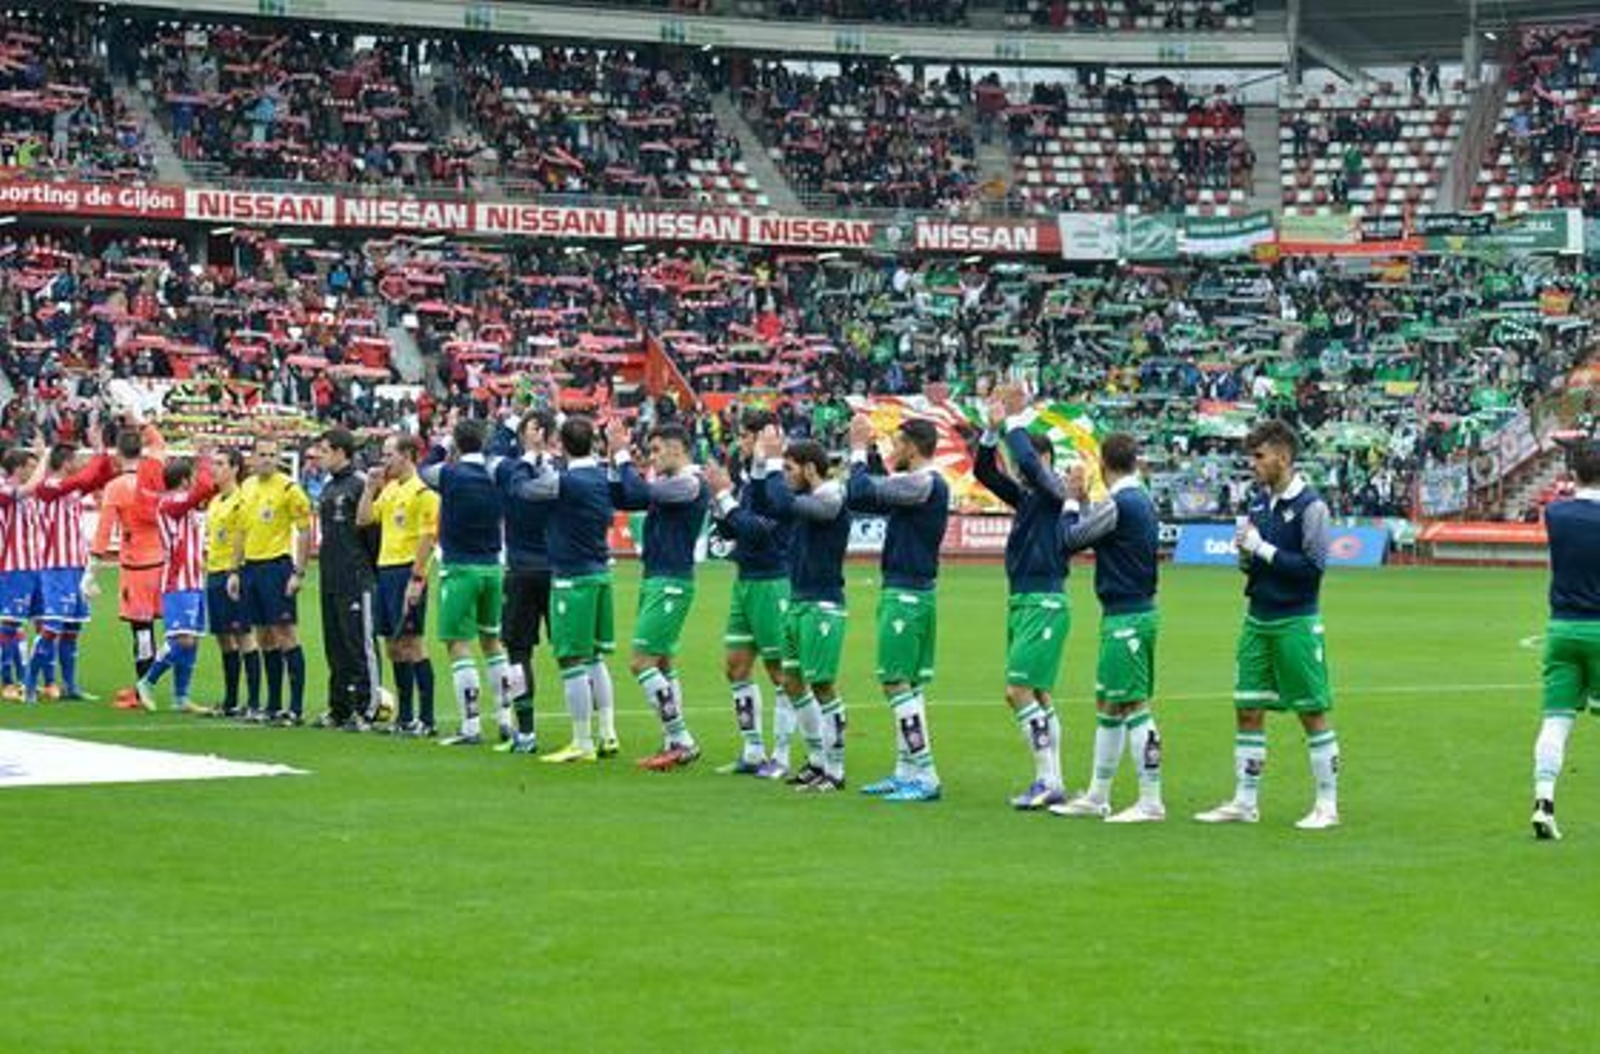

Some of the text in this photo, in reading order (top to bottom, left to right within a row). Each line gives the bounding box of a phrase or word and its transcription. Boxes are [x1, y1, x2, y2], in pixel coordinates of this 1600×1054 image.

[84, 185, 113, 206] de
[119, 188, 176, 214] Gijón
[198, 192, 324, 221] NISSAN
[344, 200, 467, 229] NISSAN
[486, 206, 607, 234] NISSAN
[627, 211, 742, 240] NISSAN
[759, 218, 873, 244] NISSAN
[916, 222, 1037, 251] NISSAN
